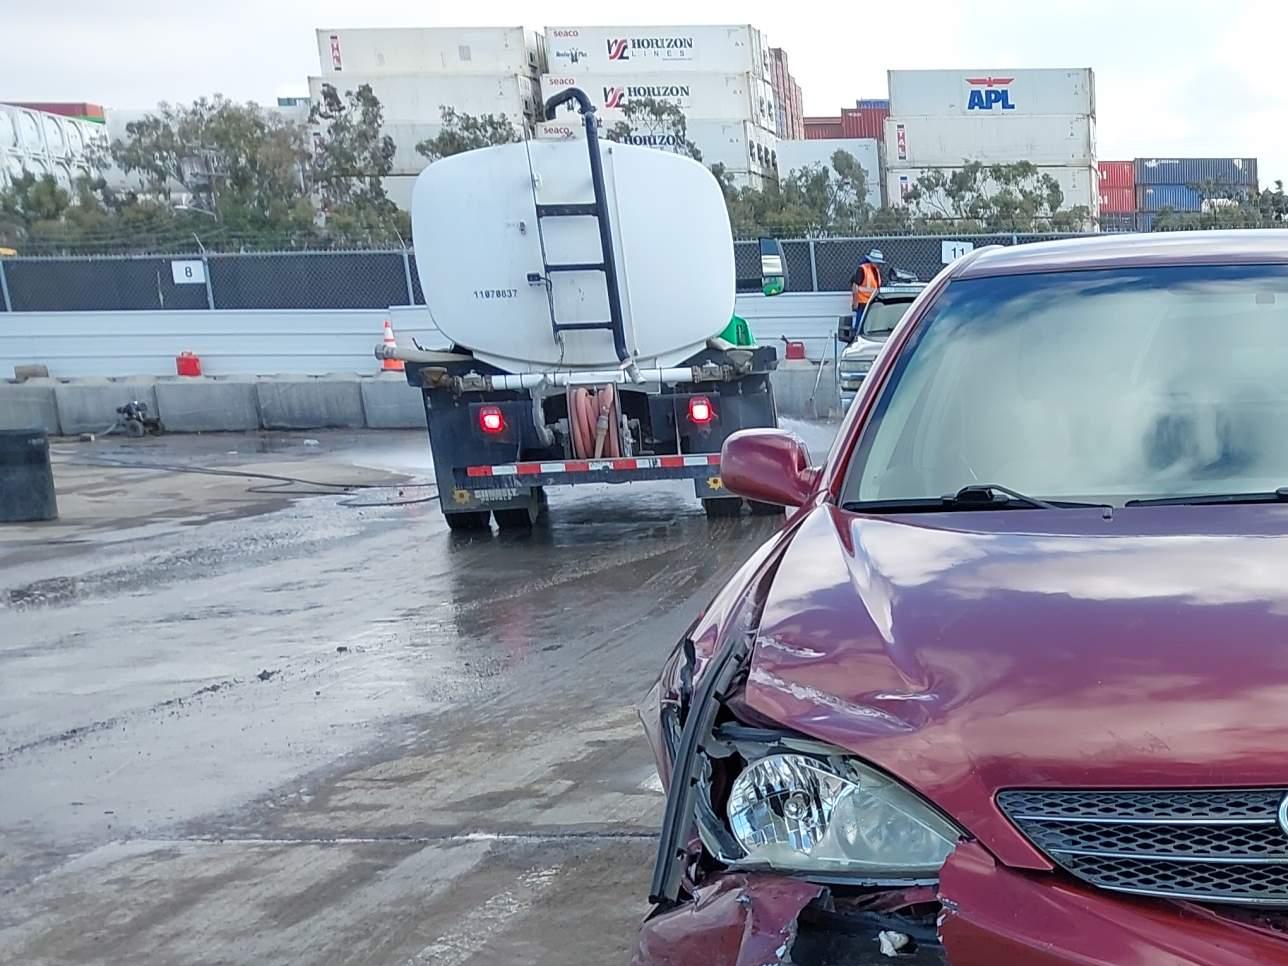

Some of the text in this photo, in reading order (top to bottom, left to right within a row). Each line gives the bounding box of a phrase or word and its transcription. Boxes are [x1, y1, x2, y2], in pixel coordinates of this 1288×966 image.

[553, 29, 579, 37] seaco
[631, 38, 693, 49] HORIZON
[549, 77, 575, 86] seaco
[627, 86, 690, 97] HORIZON
[967, 89, 1016, 110] APL
[543, 126, 570, 135] seaco
[951, 247, 965, 259] 11
[184, 266, 193, 278] 8
